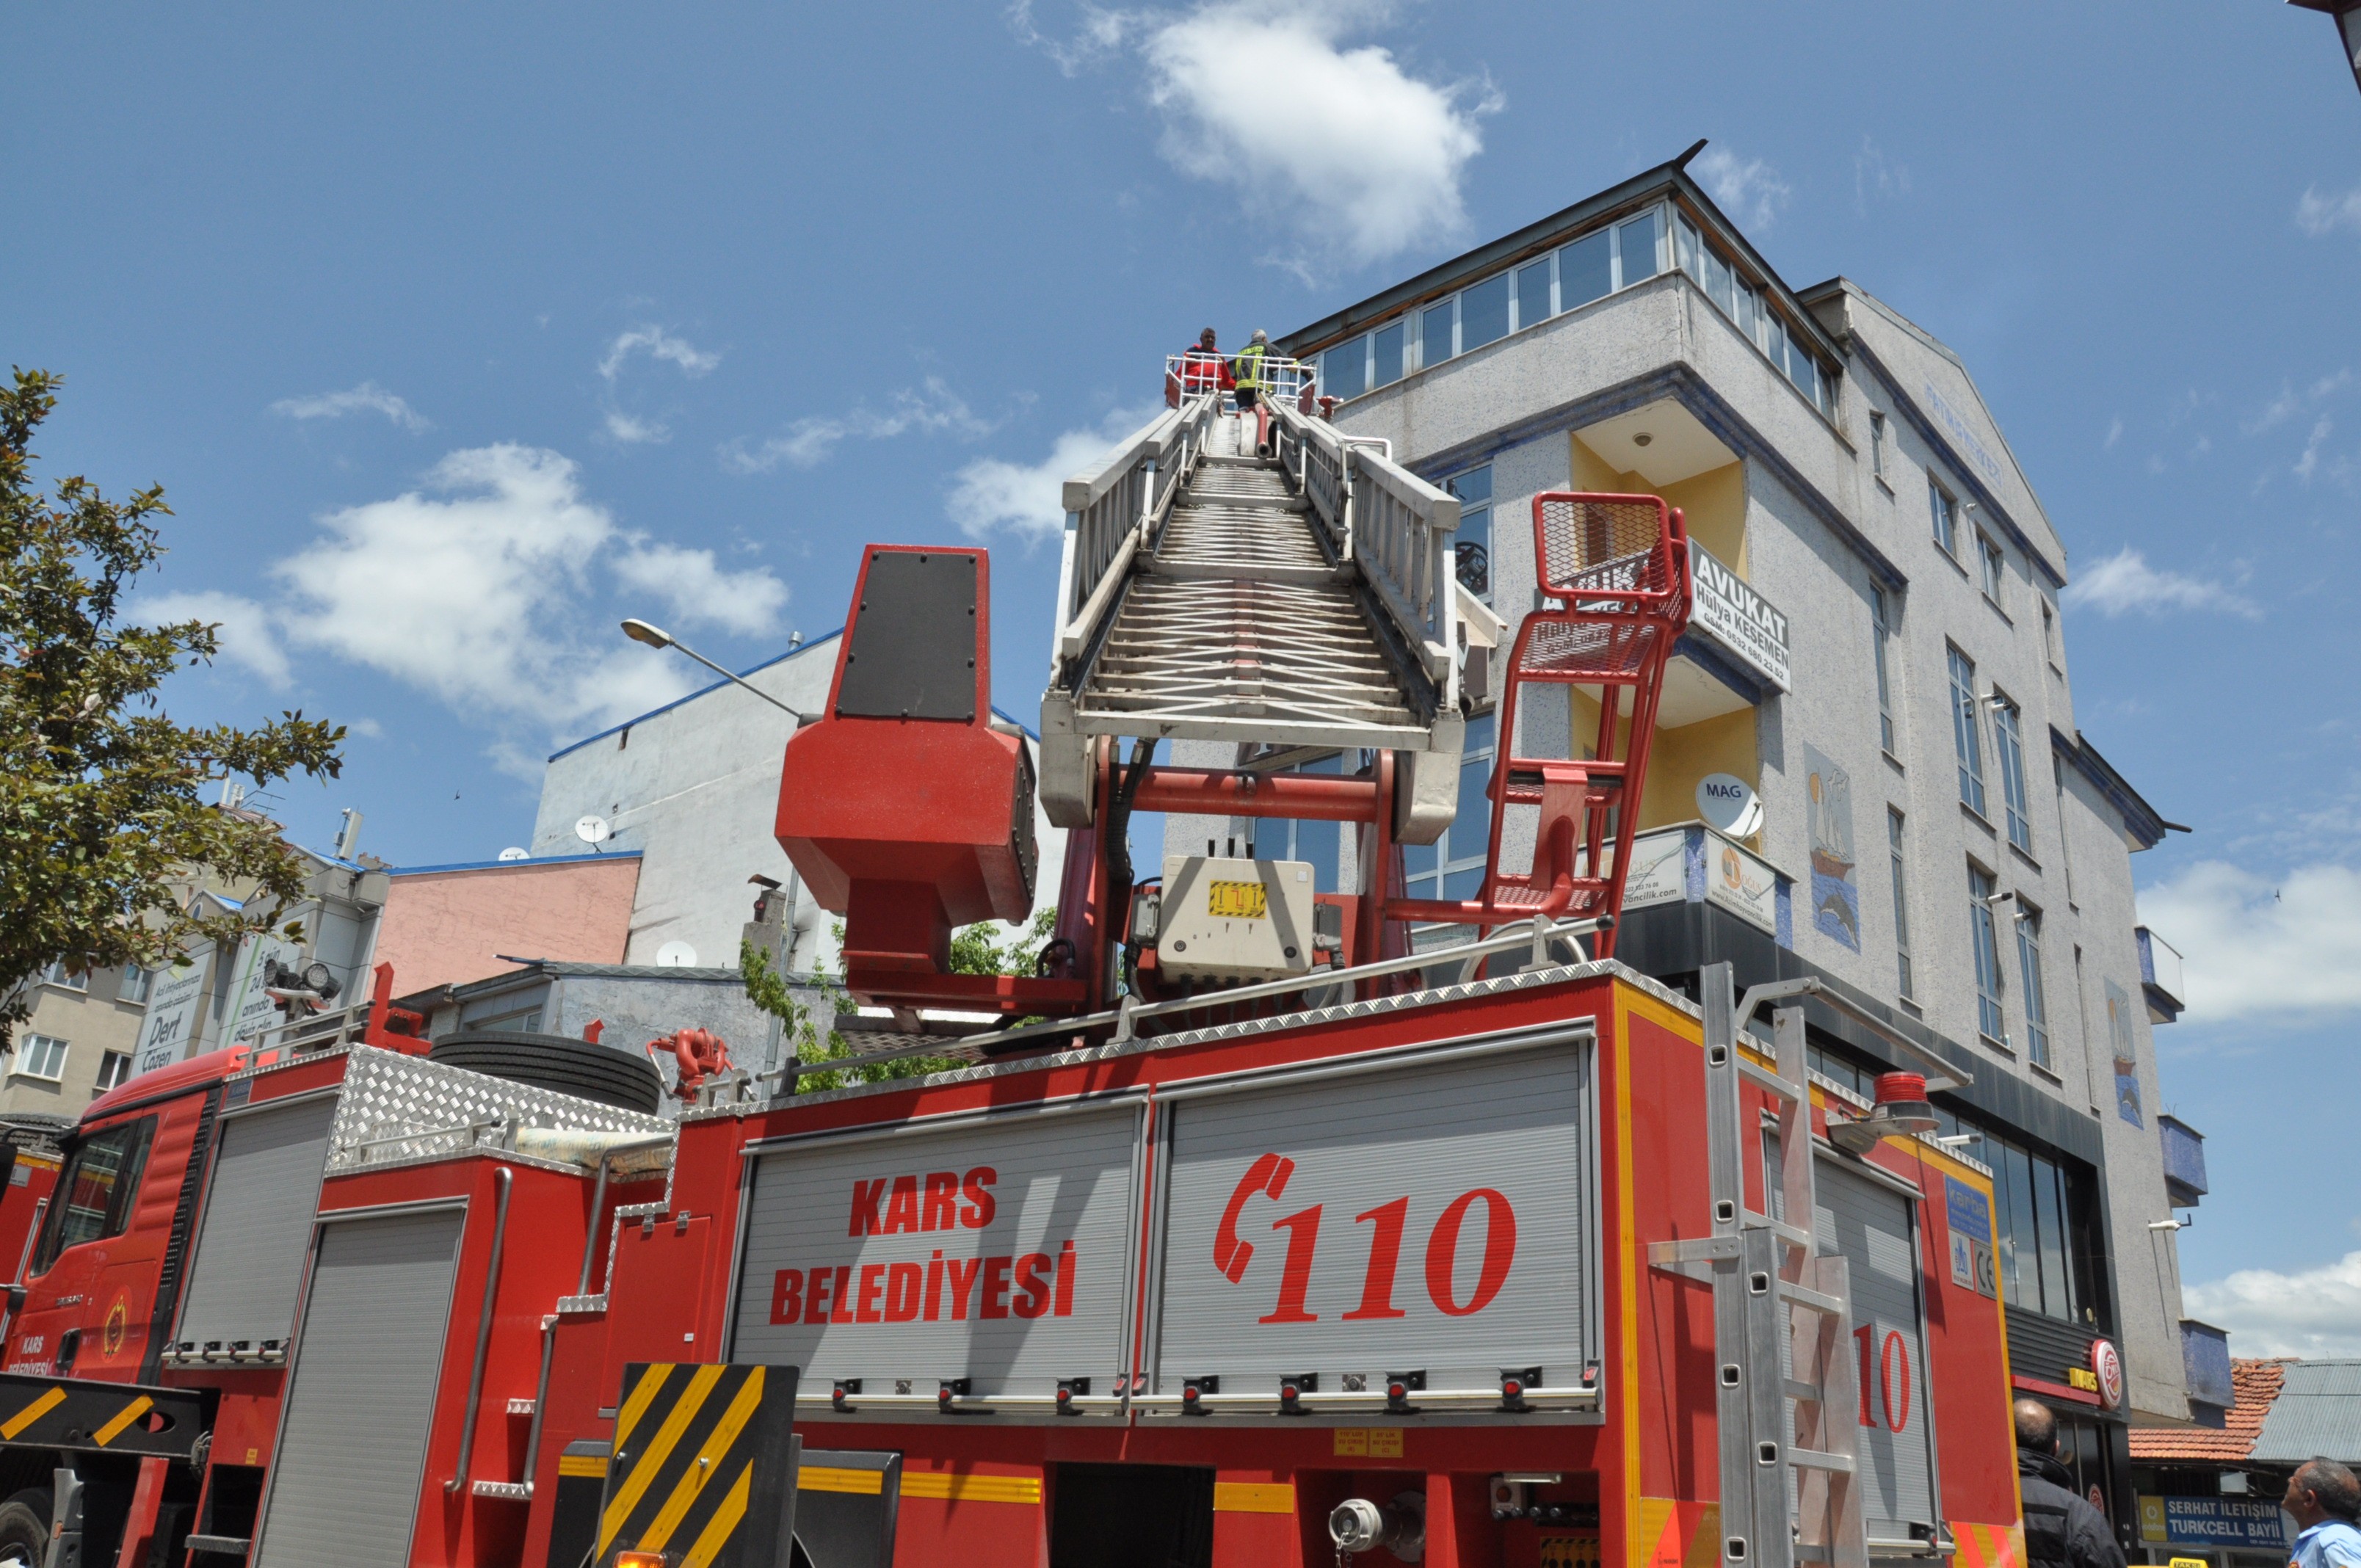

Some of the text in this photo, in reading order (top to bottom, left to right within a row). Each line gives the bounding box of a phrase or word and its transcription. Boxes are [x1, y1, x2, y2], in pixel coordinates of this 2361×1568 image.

[1697, 553, 1785, 644] AVUKAT
[1697, 582, 1789, 671] Hülya KESEMEN
[1704, 612, 1784, 680] GSM: 0532 680 23 52
[1706, 783, 1741, 798] MAG
[1623, 889, 1677, 904] vancilik.com
[250, 975, 262, 992] 24
[148, 1011, 182, 1047] Dert
[849, 1166, 998, 1237] KARS
[1258, 1188, 1516, 1324] 110
[769, 1240, 1077, 1325] BELEDİYESİ
[21, 1335, 44, 1354] KARS
[1852, 1324, 1911, 1433] 10
[2169, 1500, 2277, 1520] SERHAT İLETİŞİM
[2169, 1519, 2281, 1538] TURKCELL BAYİİ
